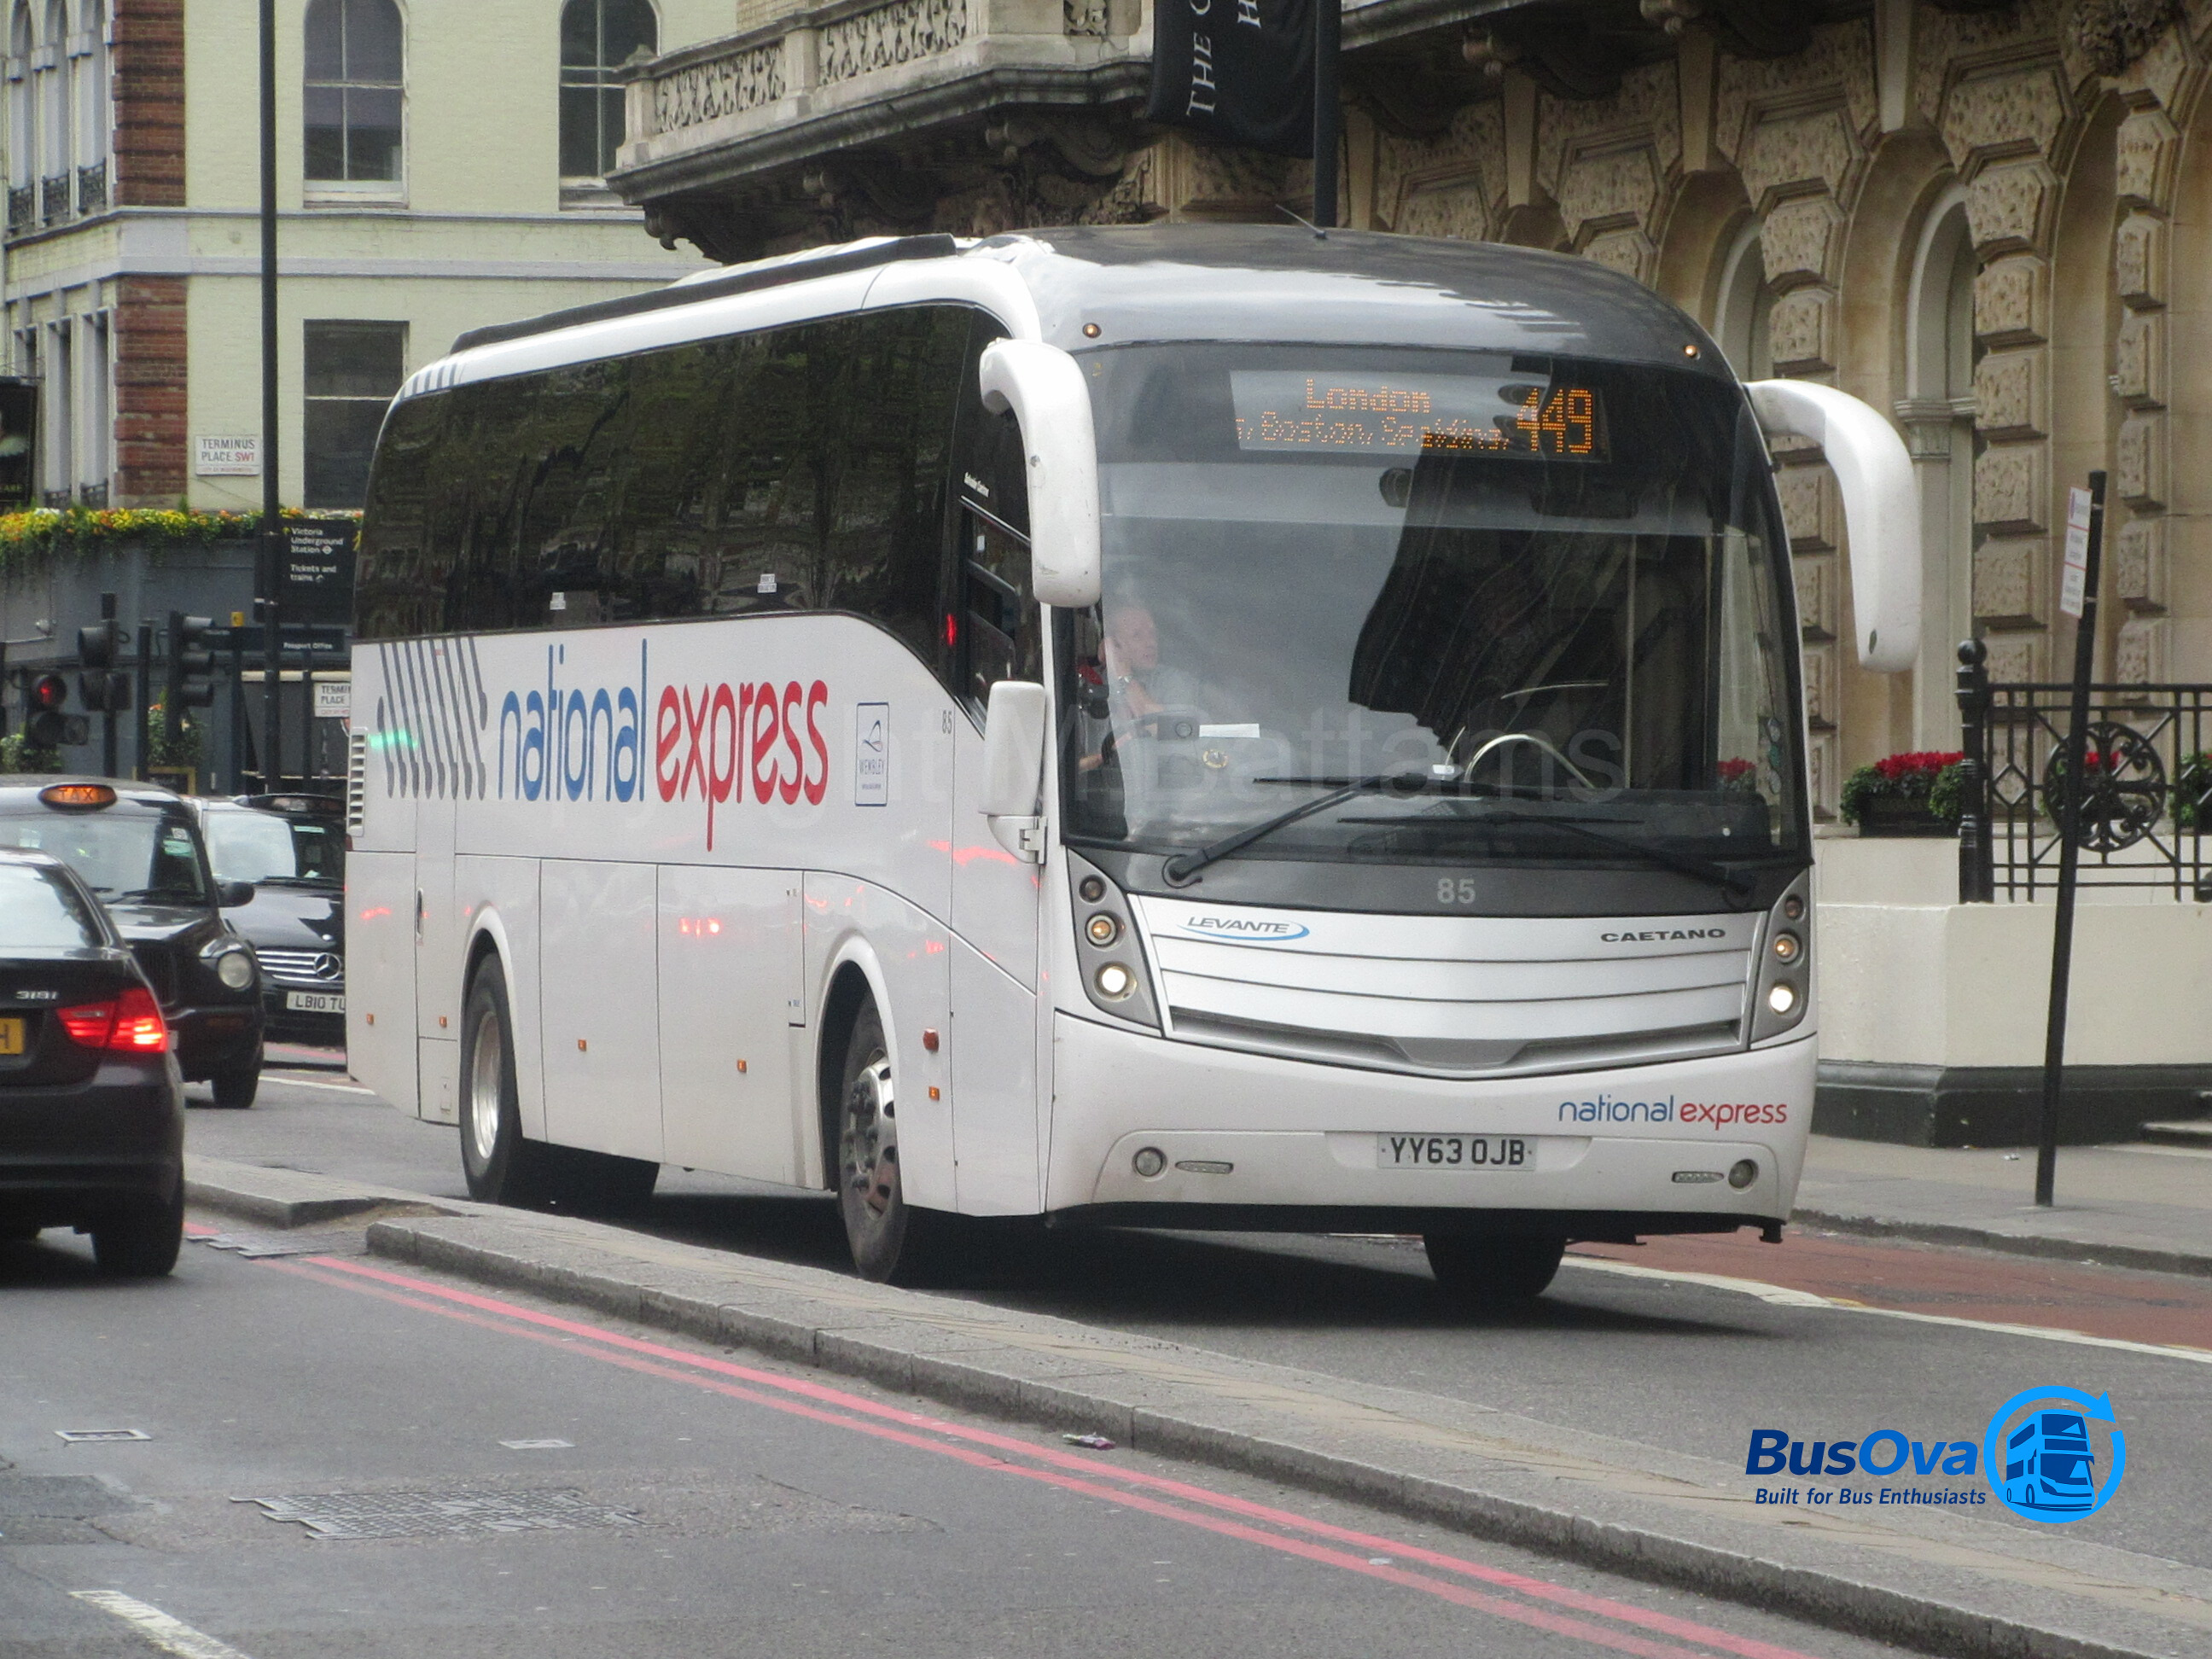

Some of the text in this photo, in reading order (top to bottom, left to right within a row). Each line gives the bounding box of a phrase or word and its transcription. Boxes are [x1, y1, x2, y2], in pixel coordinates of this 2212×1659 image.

[1186, 32, 1215, 117] THE
[1306, 378, 1430, 414] London
[1516, 387, 1593, 454] 449
[202, 439, 254, 449] TERMINUS
[201, 451, 254, 462] PLACE SW1
[291, 527, 323, 536] Victoria
[291, 537, 344, 546] Underground
[291, 545, 320, 554] Station
[290, 563, 319, 573] Tickets
[321, 696, 344, 704] PLACE
[942, 709, 952, 735] 85
[498, 637, 829, 853] national express
[1437, 878, 1476, 905] 85
[1187, 916, 1290, 934] LEVANTE
[1600, 928, 1726, 942] CAETANO
[1558, 1094, 1787, 1131] national express
[1391, 1137, 1525, 1165] YY63 OJB
